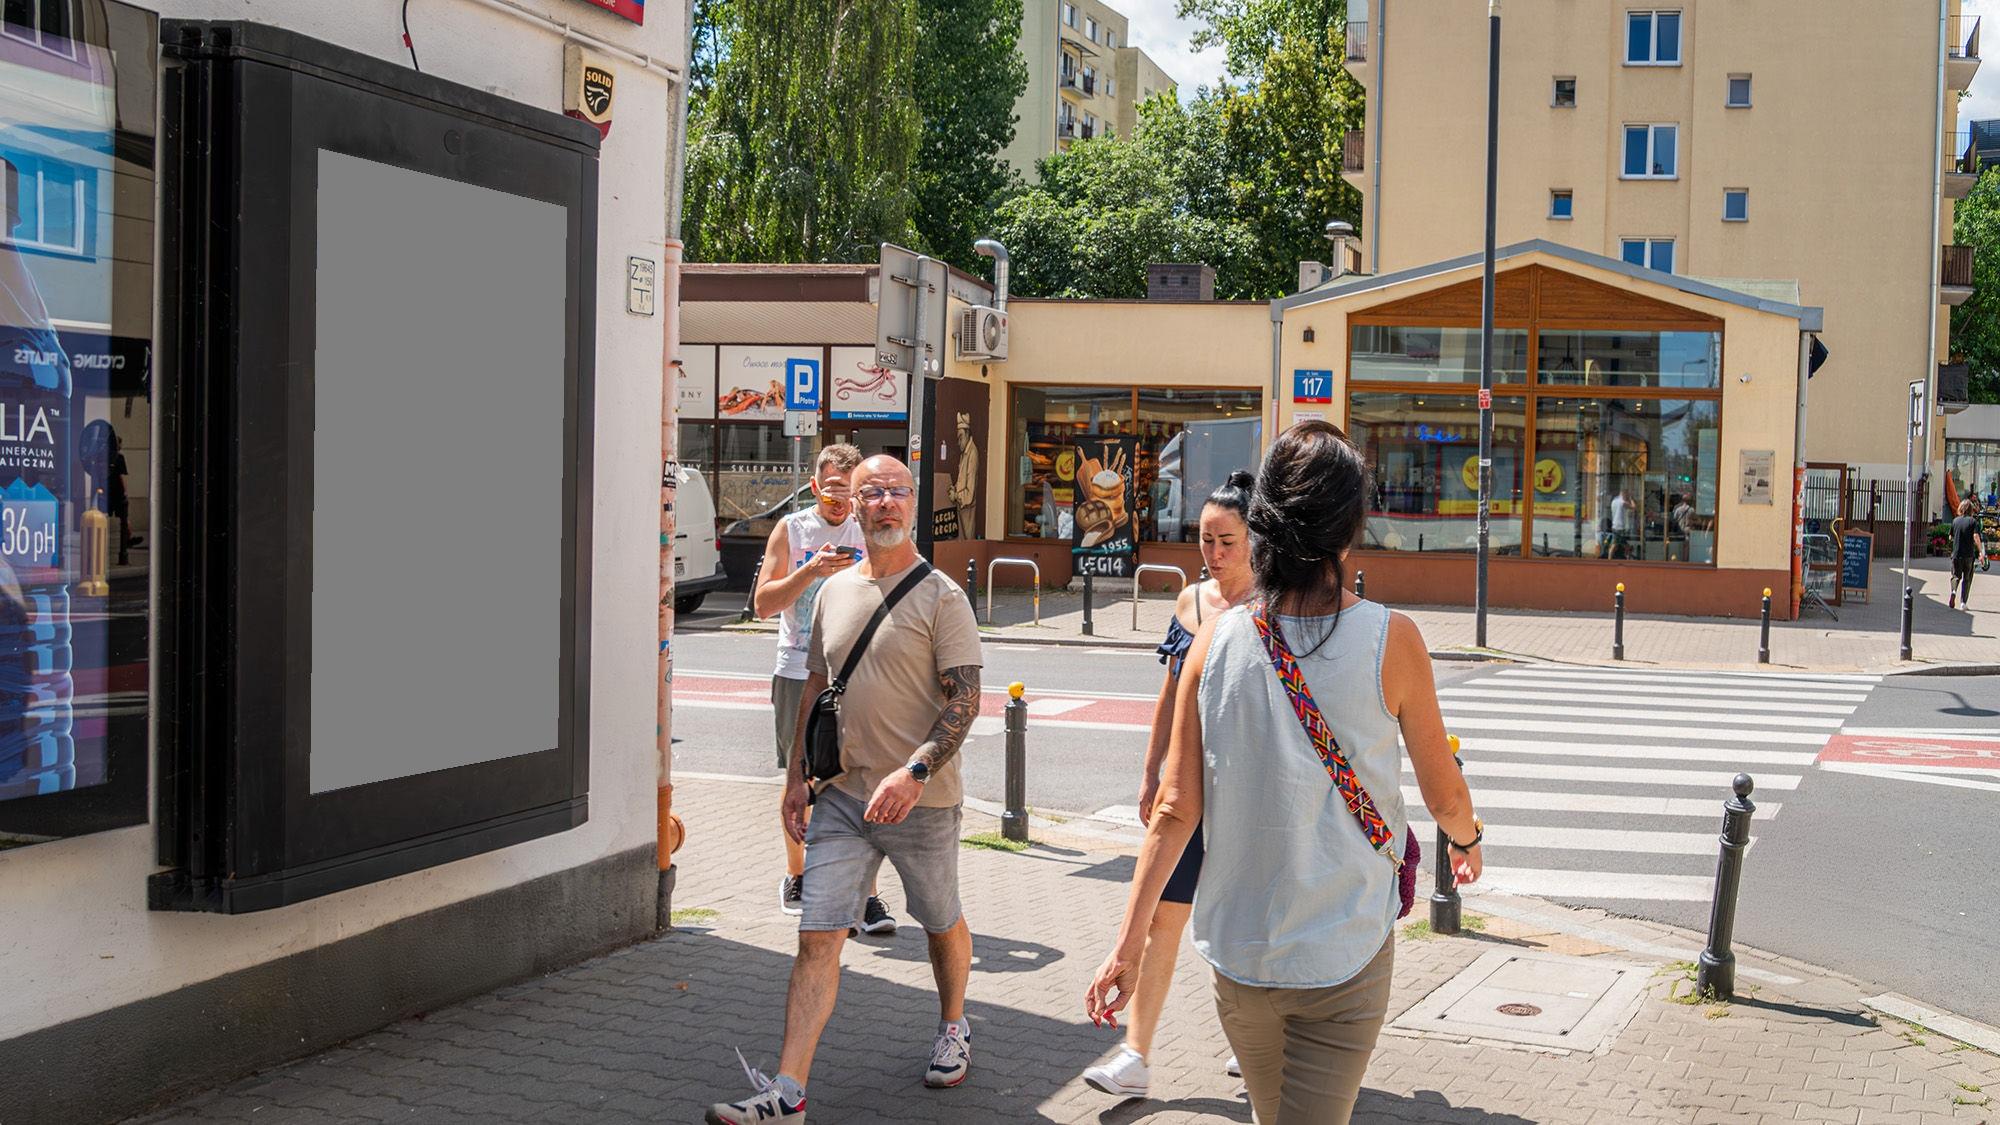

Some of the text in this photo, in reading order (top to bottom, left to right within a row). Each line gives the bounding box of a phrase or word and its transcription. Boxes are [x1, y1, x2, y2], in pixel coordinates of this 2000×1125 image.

[586, 70, 611, 88] SOLID
[793, 364, 813, 404] P
[1302, 377, 1324, 396] 117
[731, 464, 809, 474] SKLEP RYBY
[34, 522, 56, 562] pH
[1101, 537, 1129, 554] 1955
